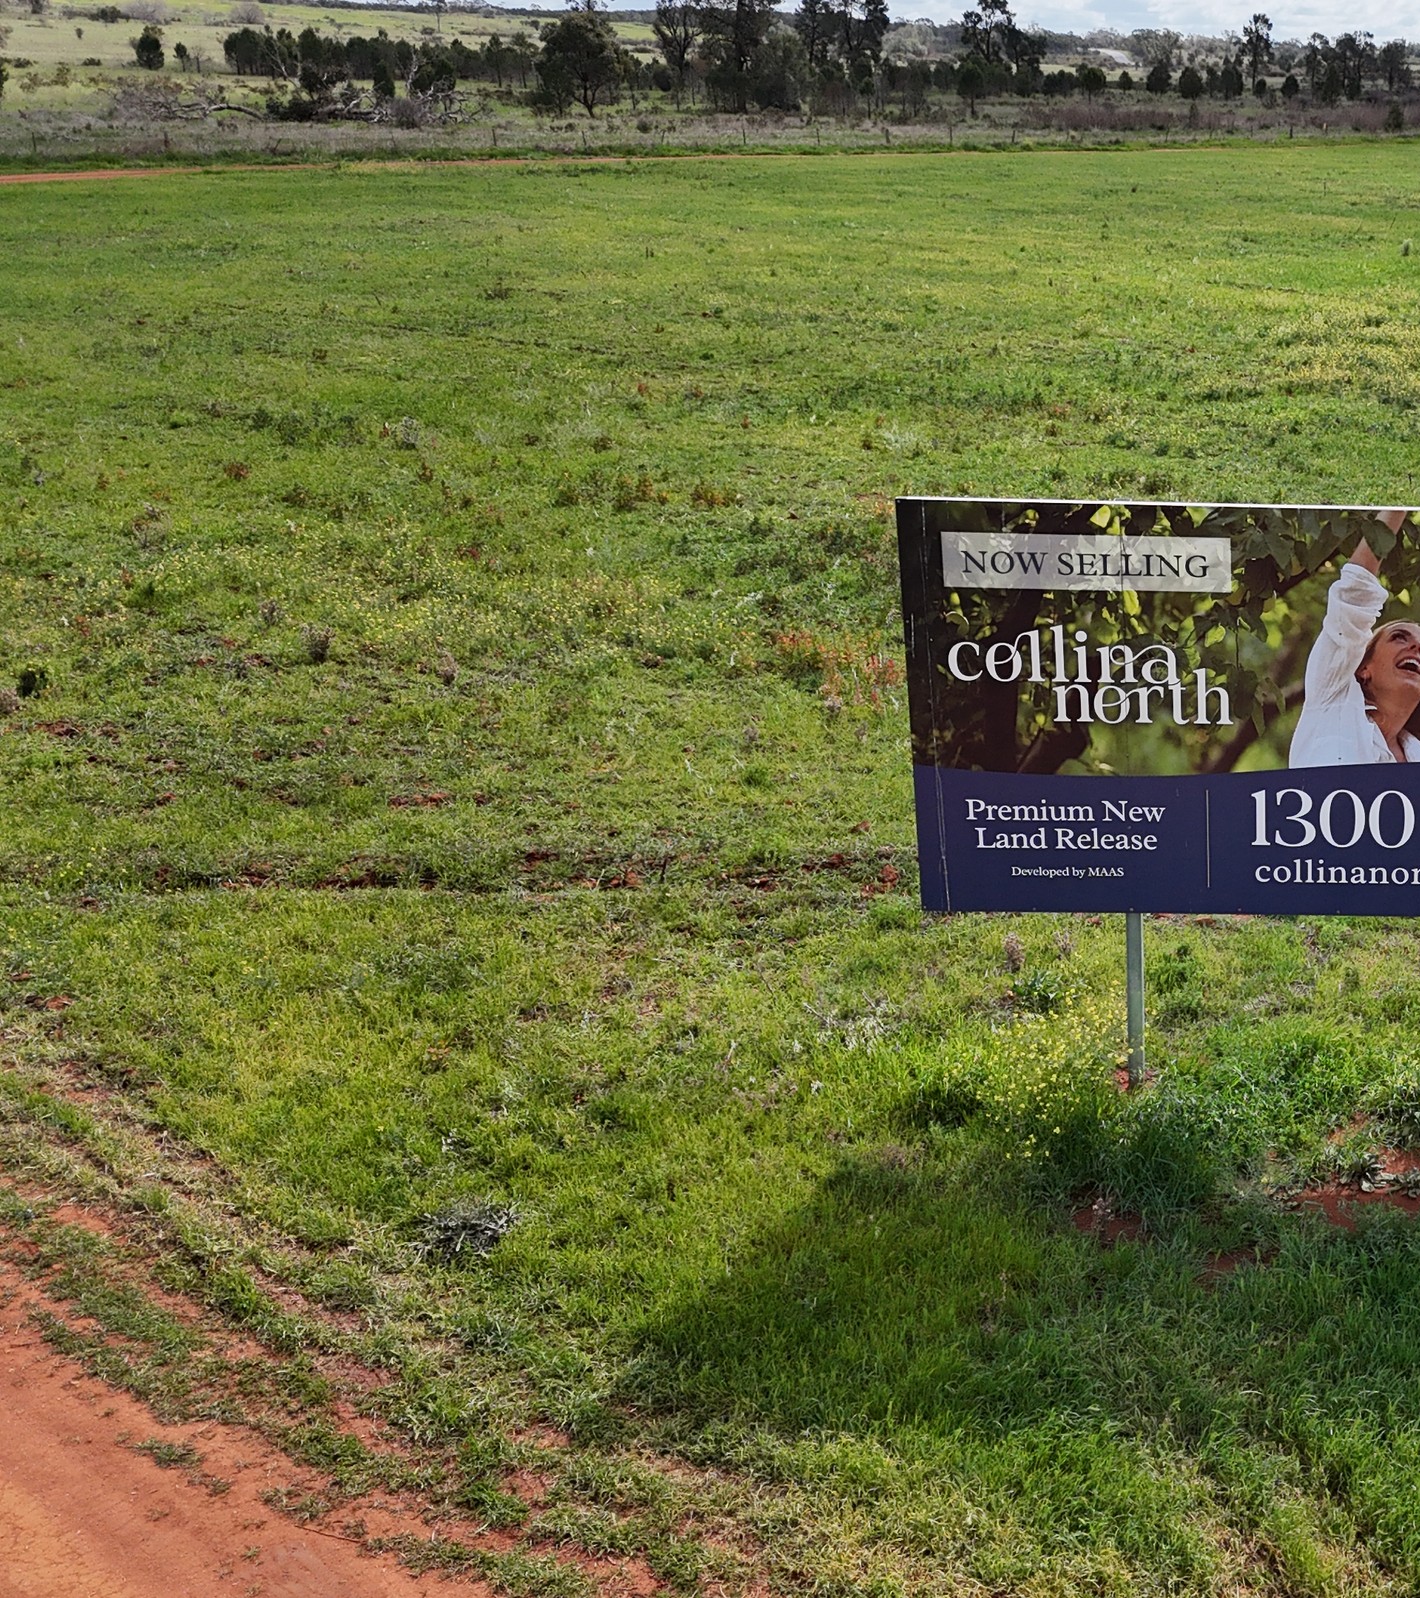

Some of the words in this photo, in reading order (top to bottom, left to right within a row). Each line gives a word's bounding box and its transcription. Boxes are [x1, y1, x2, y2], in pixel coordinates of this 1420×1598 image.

[961, 550, 1048, 575] NOW
[1058, 552, 1210, 578] SELLING
[947, 625, 1181, 685] collina
[1053, 668, 1234, 725] north
[965, 799, 1095, 822] Premium
[1101, 800, 1166, 823] New
[1250, 788, 1415, 849] 1300
[974, 827, 1048, 850] Land
[1054, 828, 1158, 851] Release
[1011, 866, 1070, 878] Developed
[1072, 866, 1086, 879] by
[1088, 867, 1124, 877] MAAS
